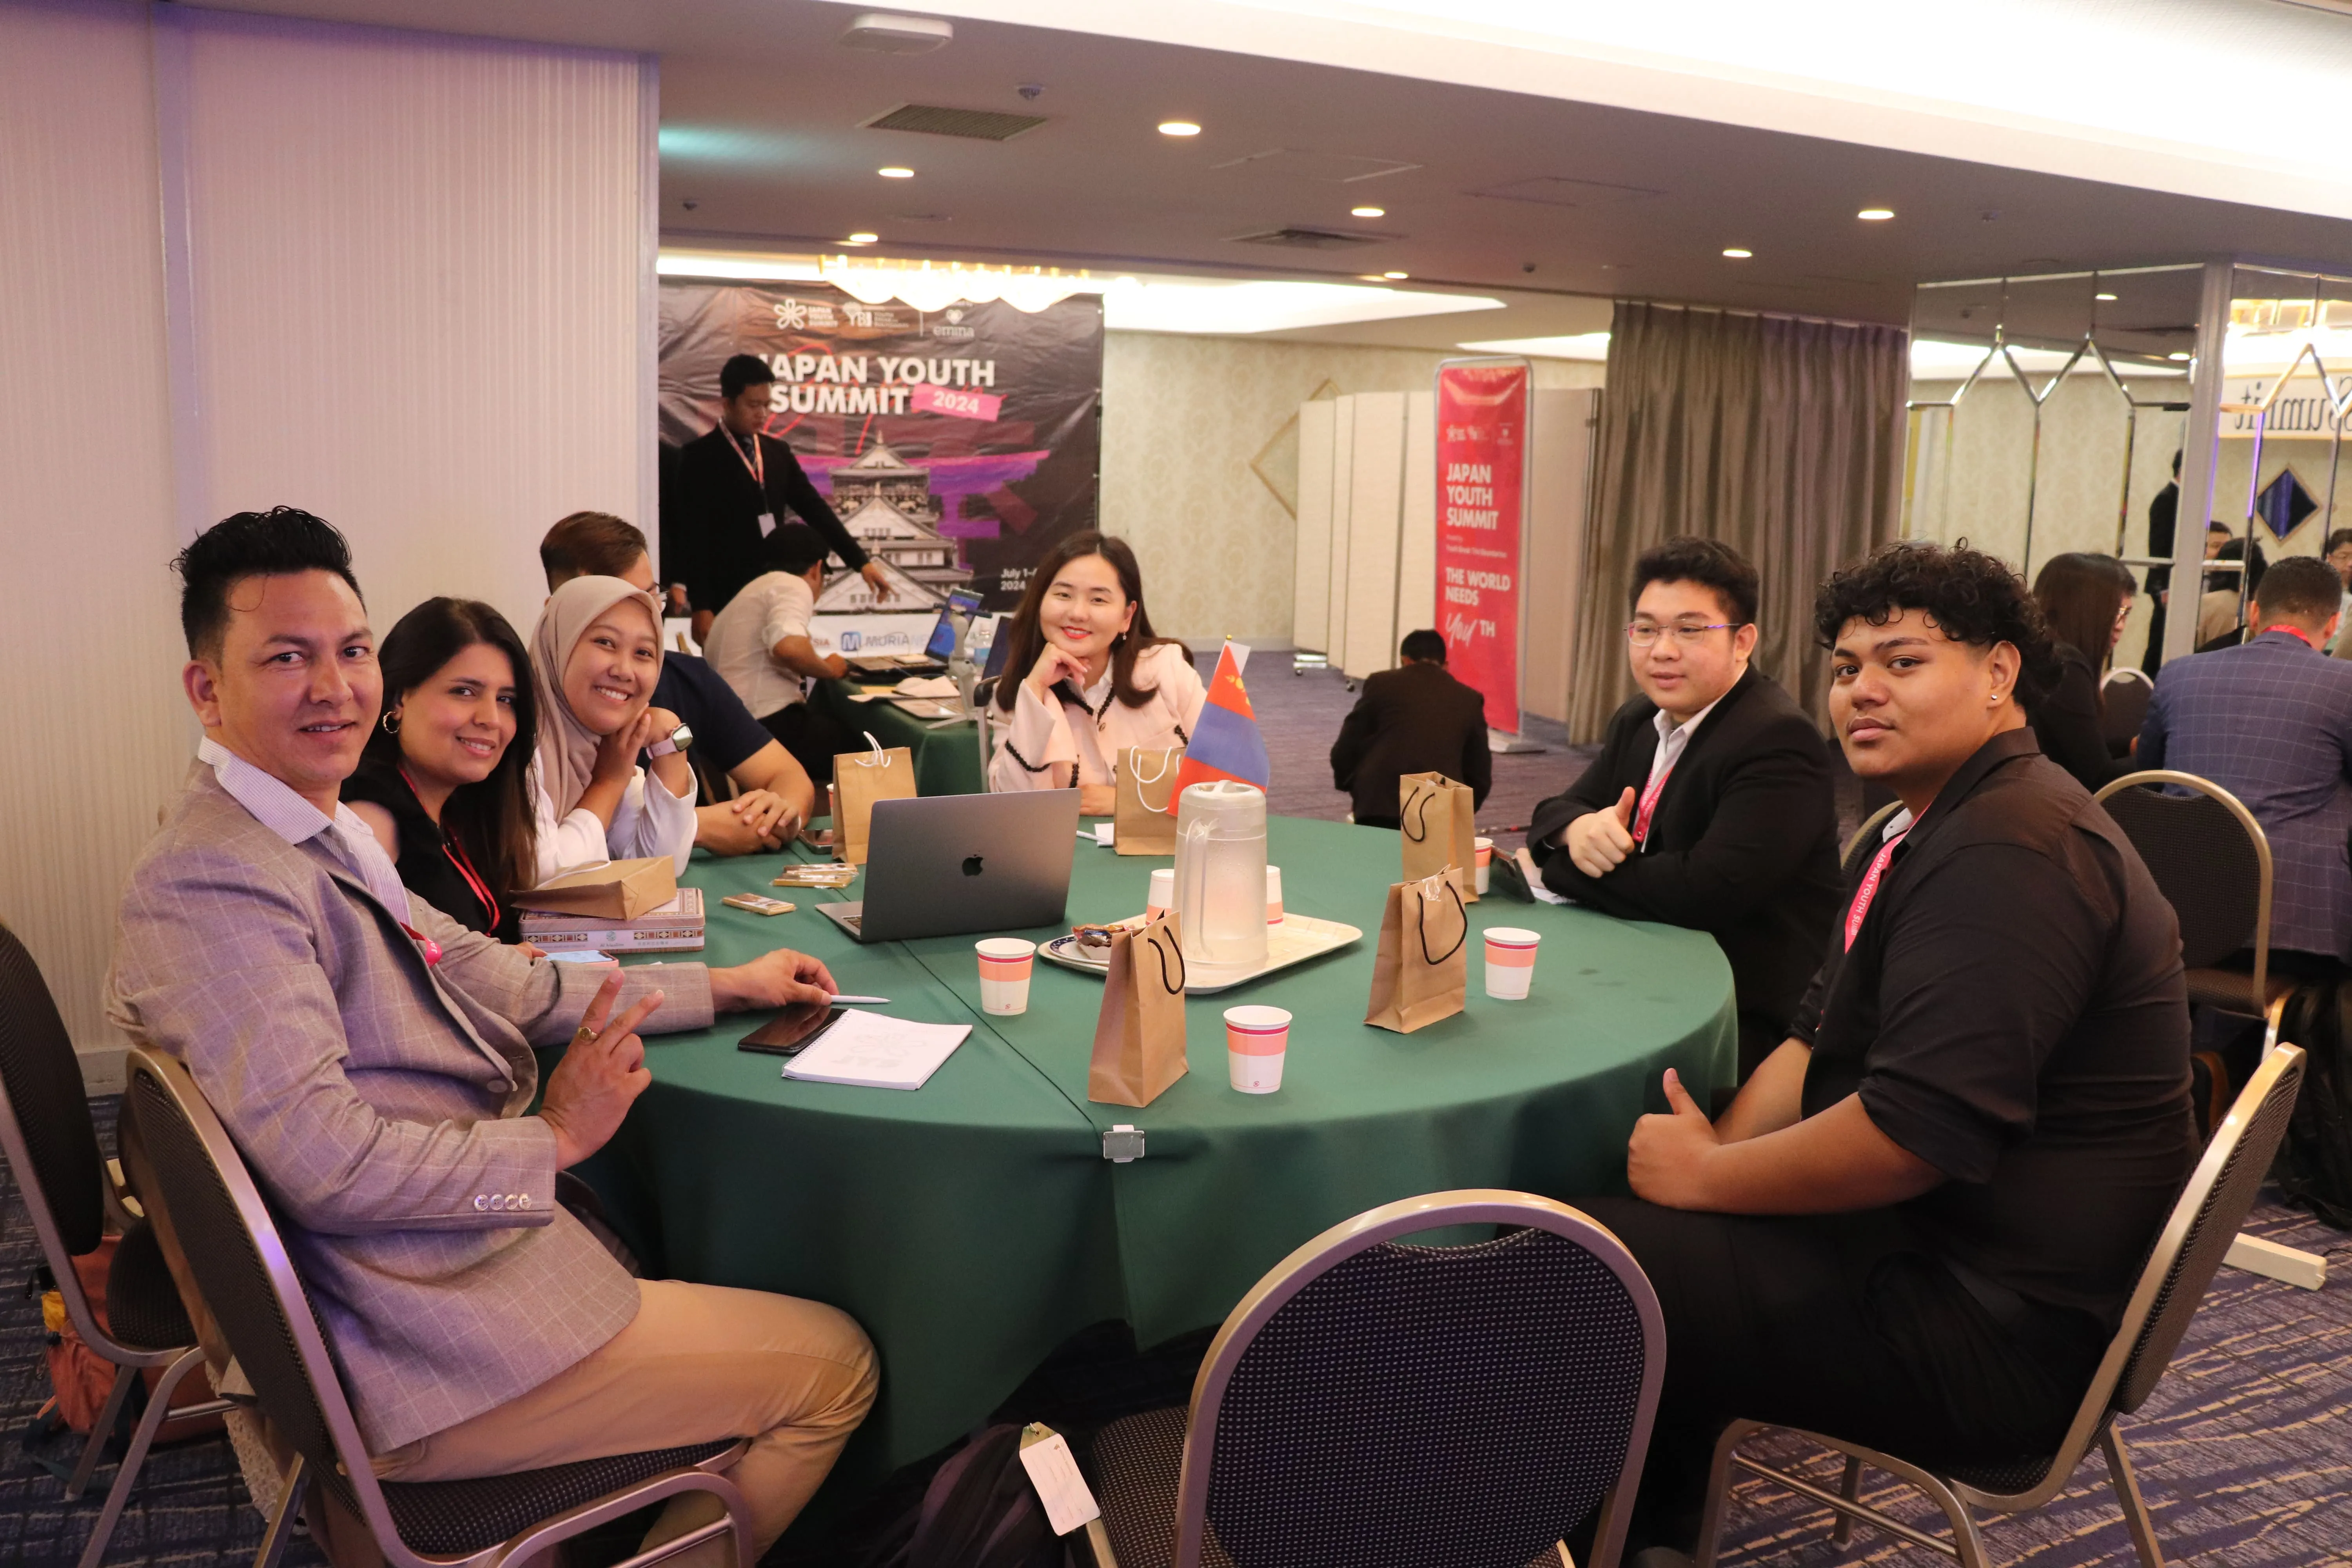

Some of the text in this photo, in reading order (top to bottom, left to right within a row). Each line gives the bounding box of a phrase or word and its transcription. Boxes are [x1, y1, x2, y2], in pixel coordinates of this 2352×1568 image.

[878, 356, 995, 387] YOUTH
[769, 385, 909, 415] SUMMIT
[933, 390, 979, 414] 2024
[1446, 463, 1492, 484] JAPAN
[1446, 485, 1493, 506] YOUTH
[1446, 507, 1499, 531] SUMMIT
[1001, 568, 1021, 579] July
[1445, 567, 1511, 592] THE WORLD
[1000, 581, 1026, 591] 2024
[1445, 585, 1479, 606] NEEDS
[1479, 619, 1496, 638] TH
[1869, 853, 1887, 882] JAPAN
[1855, 883, 1874, 913] YOUTH
